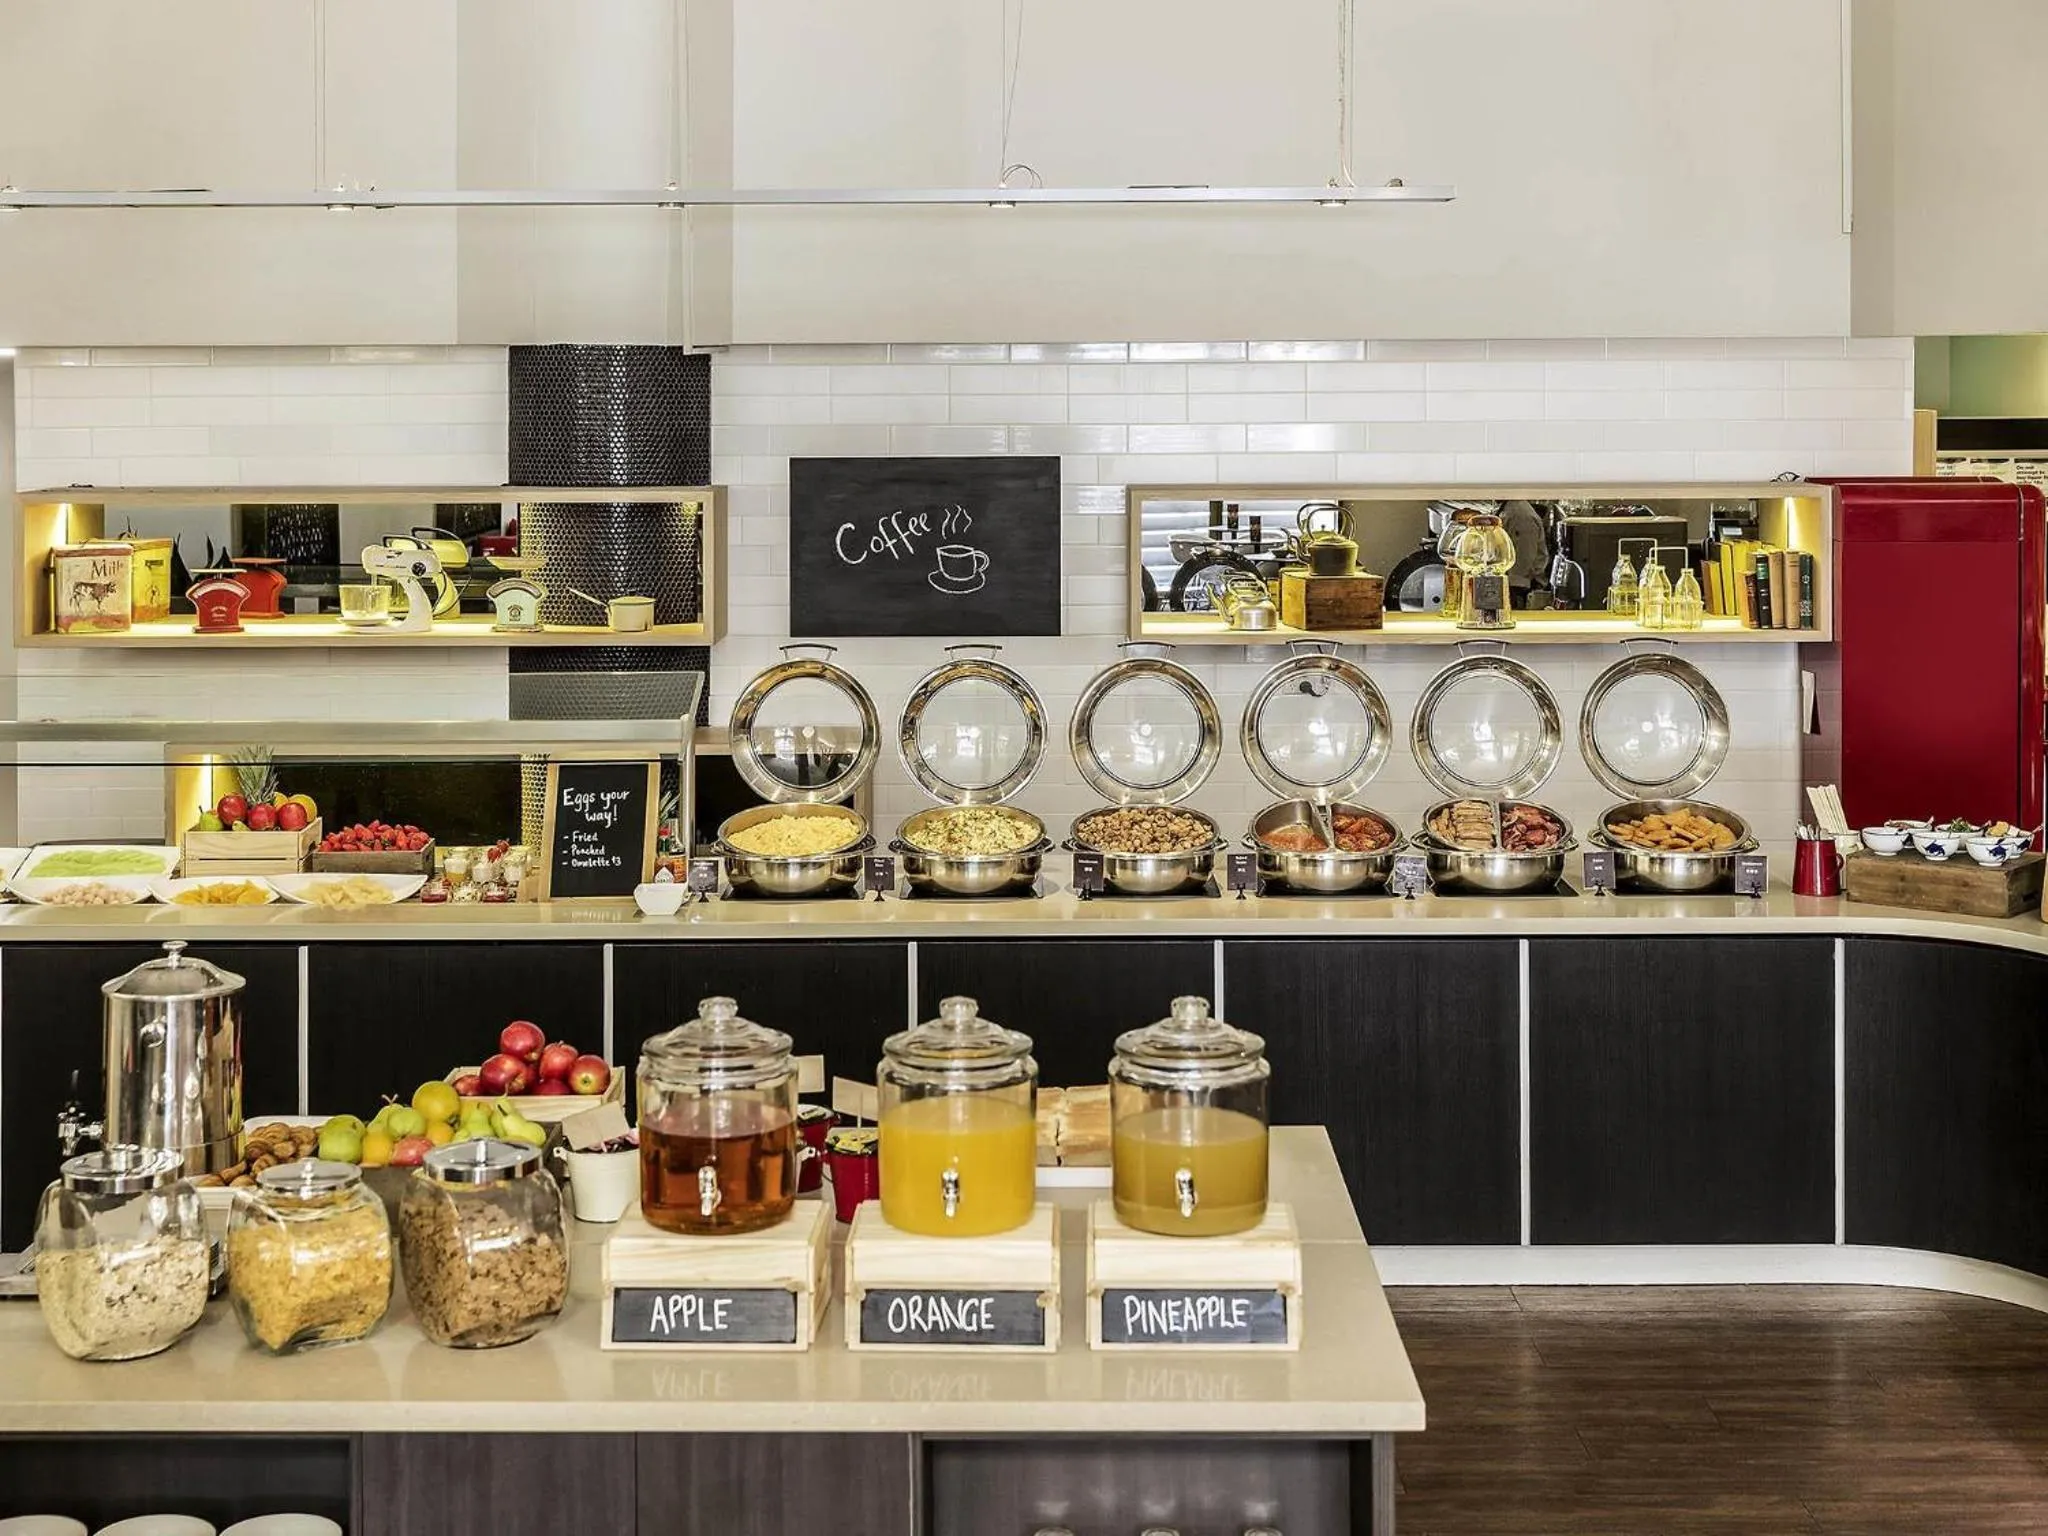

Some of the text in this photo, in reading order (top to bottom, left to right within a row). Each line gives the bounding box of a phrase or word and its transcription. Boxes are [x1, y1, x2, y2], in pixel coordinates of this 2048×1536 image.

[835, 511, 931, 564] Coffee
[563, 787, 630, 812] Eggs your
[585, 804, 618, 828] way!
[571, 843, 605, 856] Poached
[572, 830, 599, 842] Fried
[650, 1294, 733, 1334] APPLE
[888, 1295, 995, 1333] ORANGE
[1123, 1295, 1250, 1336] PINEAPPLE
